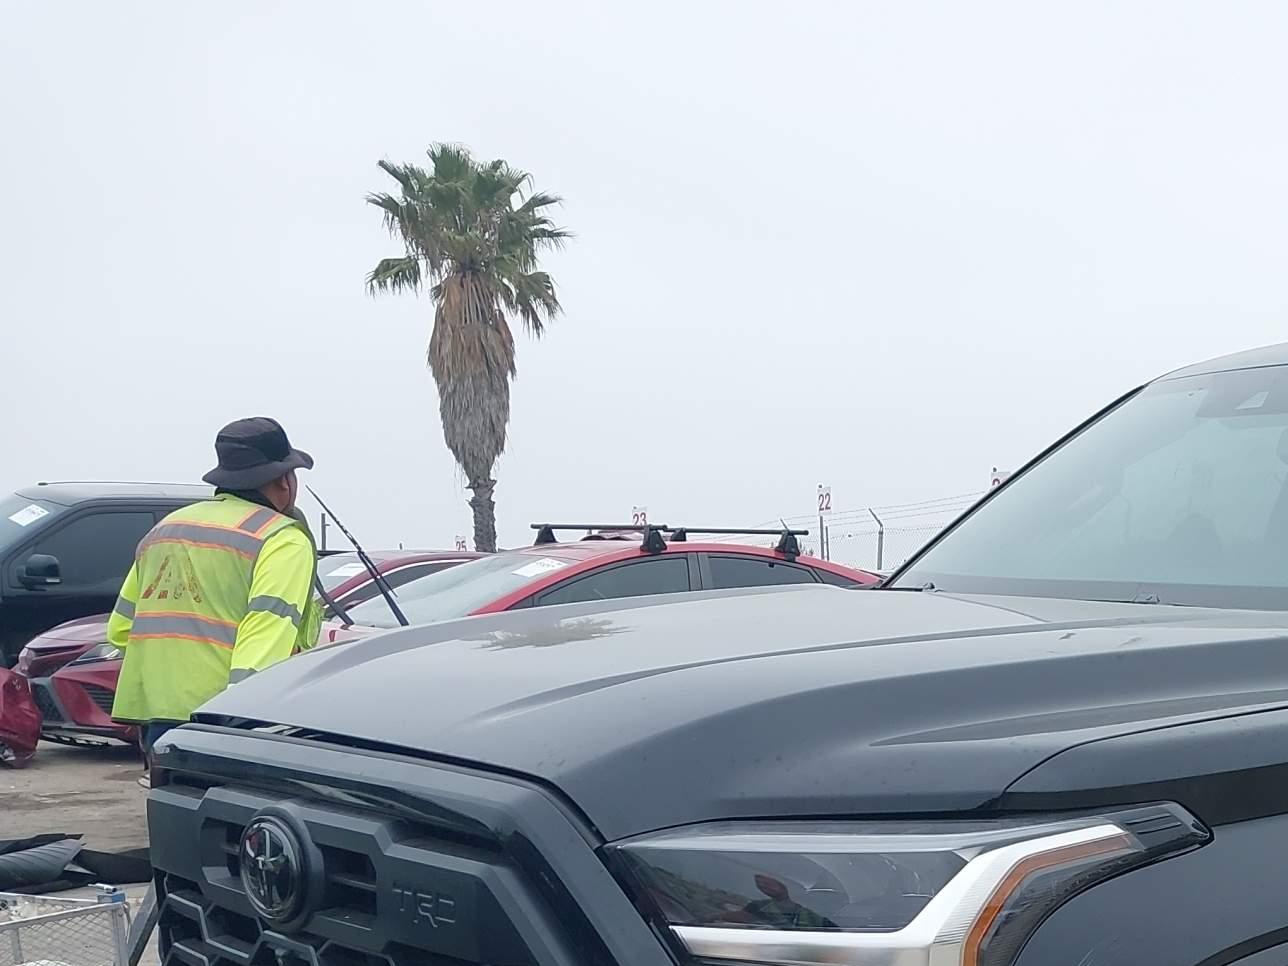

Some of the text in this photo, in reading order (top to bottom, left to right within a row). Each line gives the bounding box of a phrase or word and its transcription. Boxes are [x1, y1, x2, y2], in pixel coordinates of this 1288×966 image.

[817, 493, 831, 511] 22
[632, 511, 647, 527] 23
[391, 888, 457, 929] TRD
